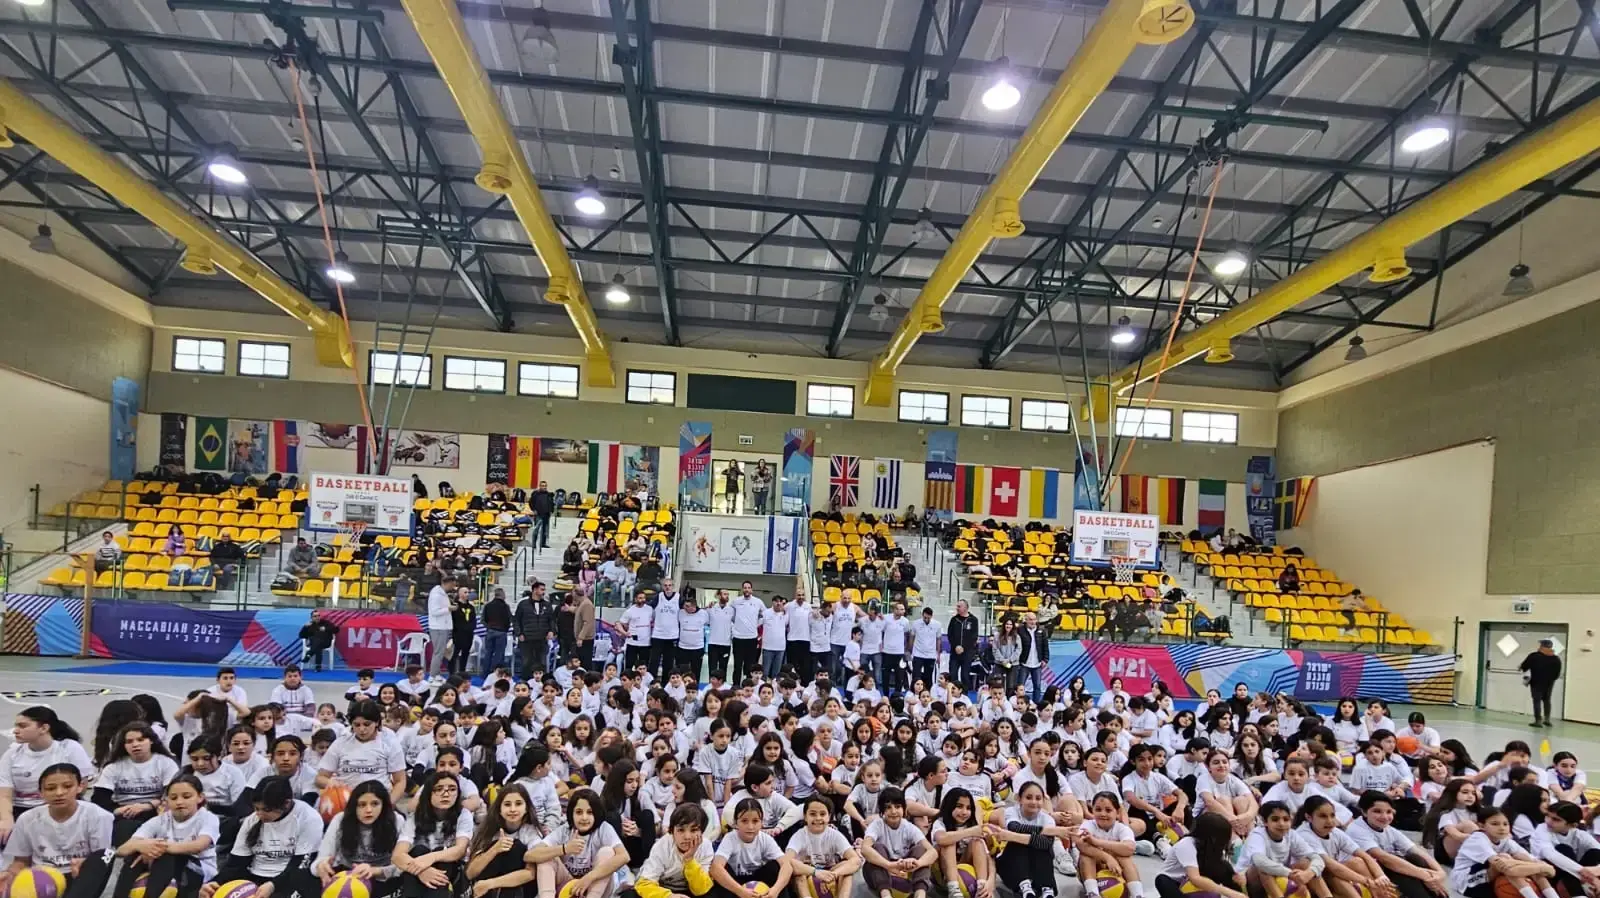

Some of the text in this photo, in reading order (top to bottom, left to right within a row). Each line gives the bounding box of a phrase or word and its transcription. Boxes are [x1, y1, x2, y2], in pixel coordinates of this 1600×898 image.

[316, 477, 409, 493] BASKETBALL
[1079, 515, 1155, 529] BASKETBALL
[120, 619, 221, 635] MACCABIAH 2022
[347, 627, 392, 649] M21
[1108, 656, 1147, 678] M21
[1306, 661, 1332, 673] ישראל
[1306, 671, 1331, 682] חוגגת
[1305, 681, 1331, 691] ספורט
